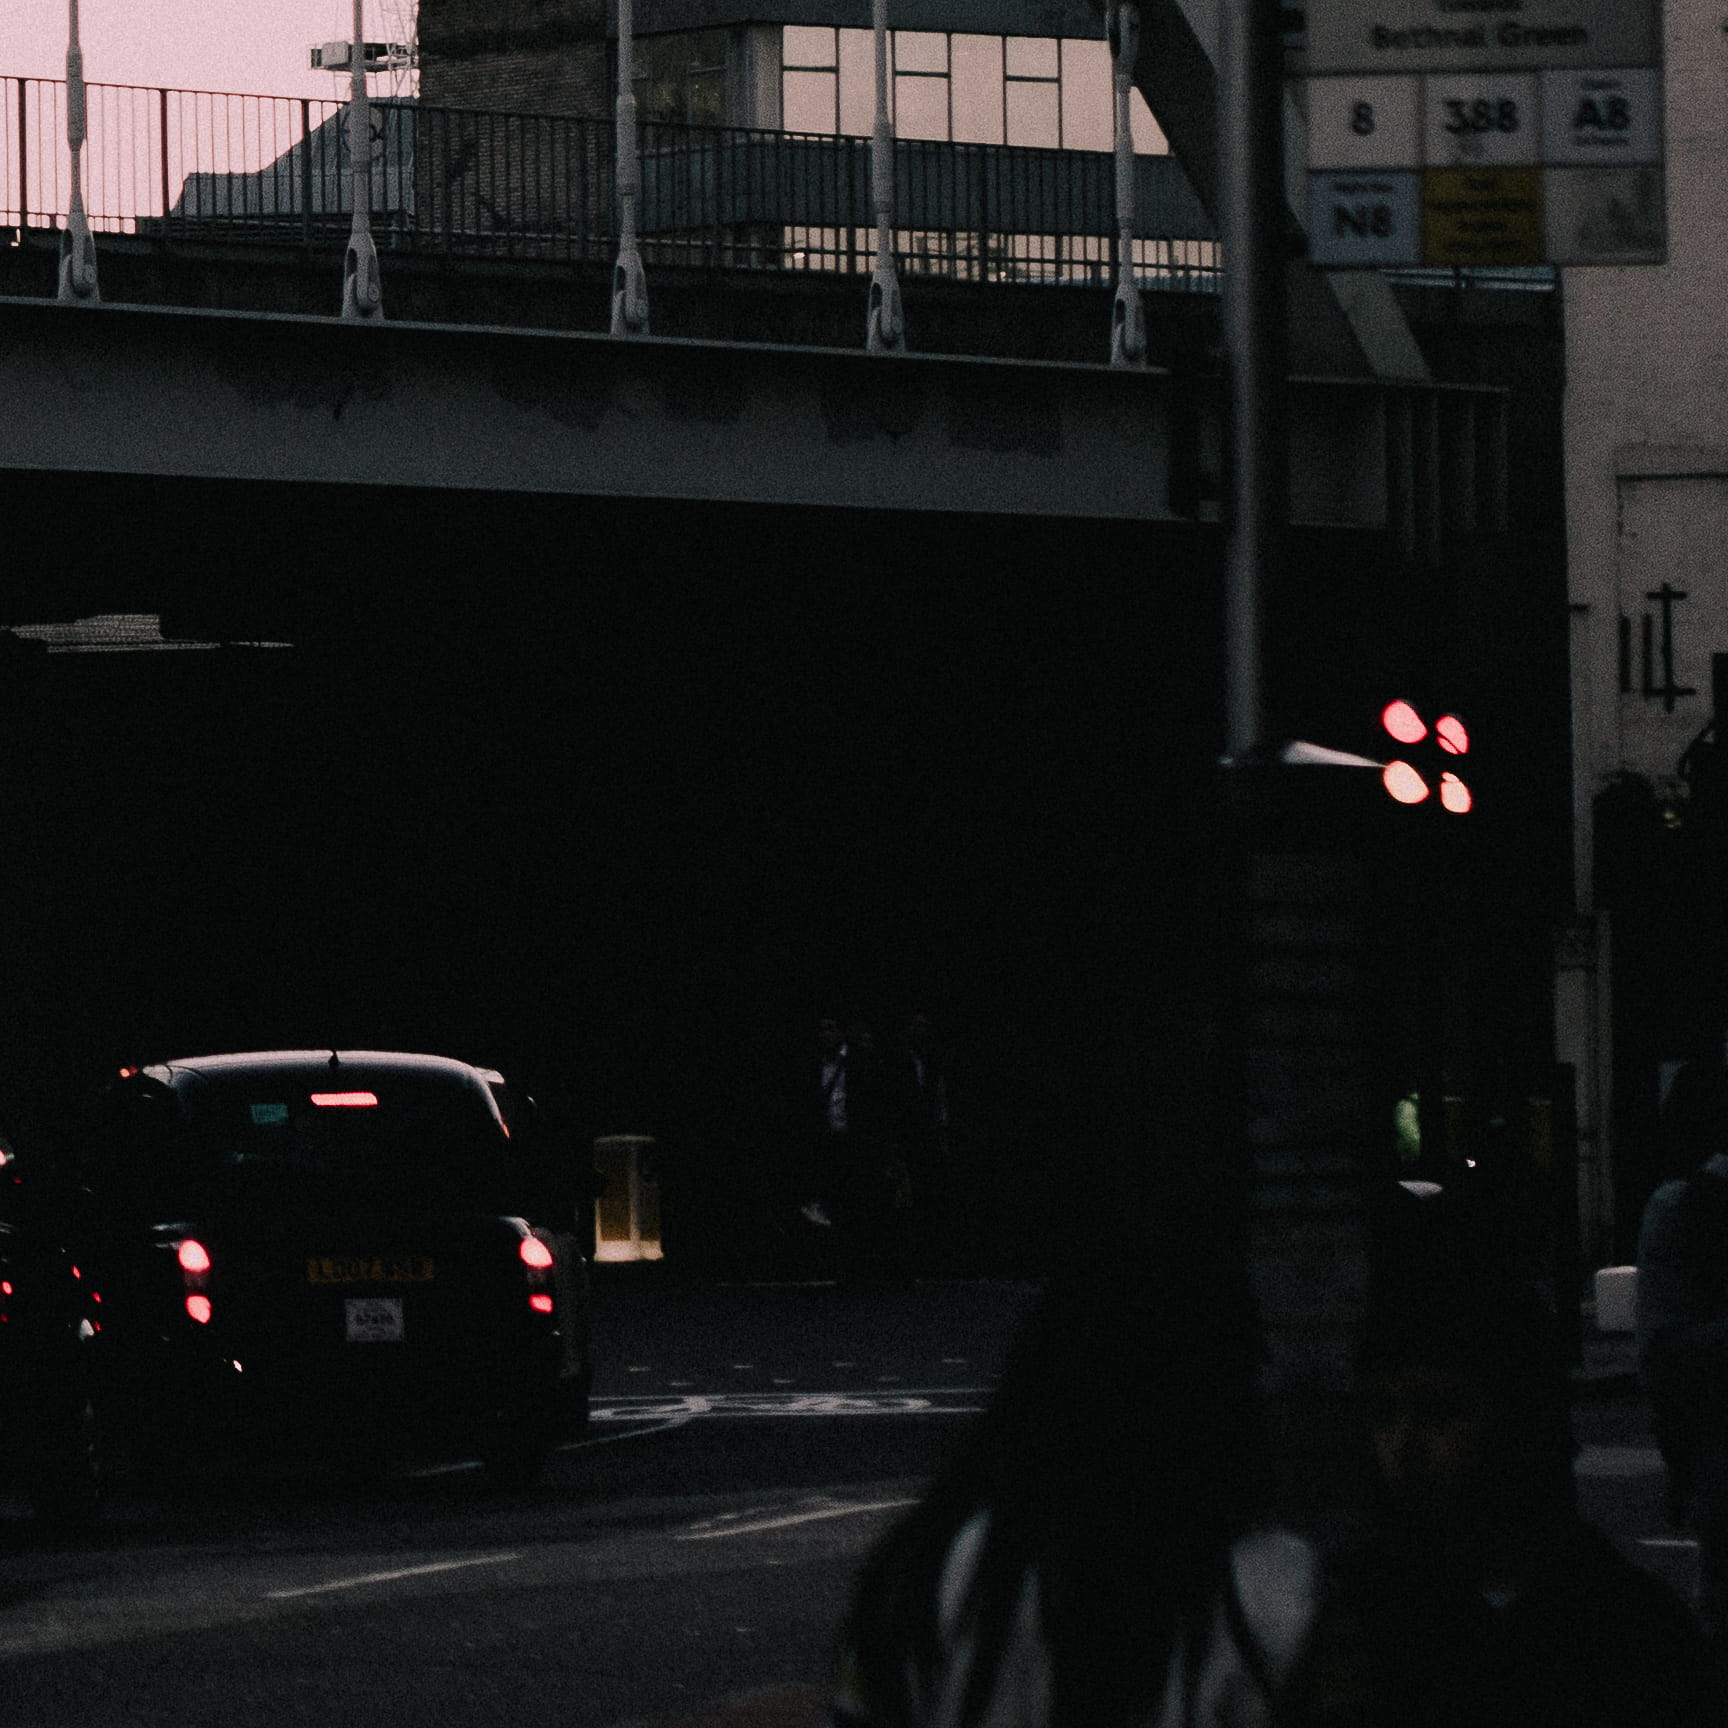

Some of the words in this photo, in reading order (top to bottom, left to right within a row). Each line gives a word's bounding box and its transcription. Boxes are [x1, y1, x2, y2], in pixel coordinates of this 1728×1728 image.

[1370, 24, 1487, 50] Bethnal
[1497, 21, 1589, 47] Green
[1349, 100, 1376, 135] 8
[1442, 97, 1521, 134] 388
[1333, 203, 1394, 239] N8
